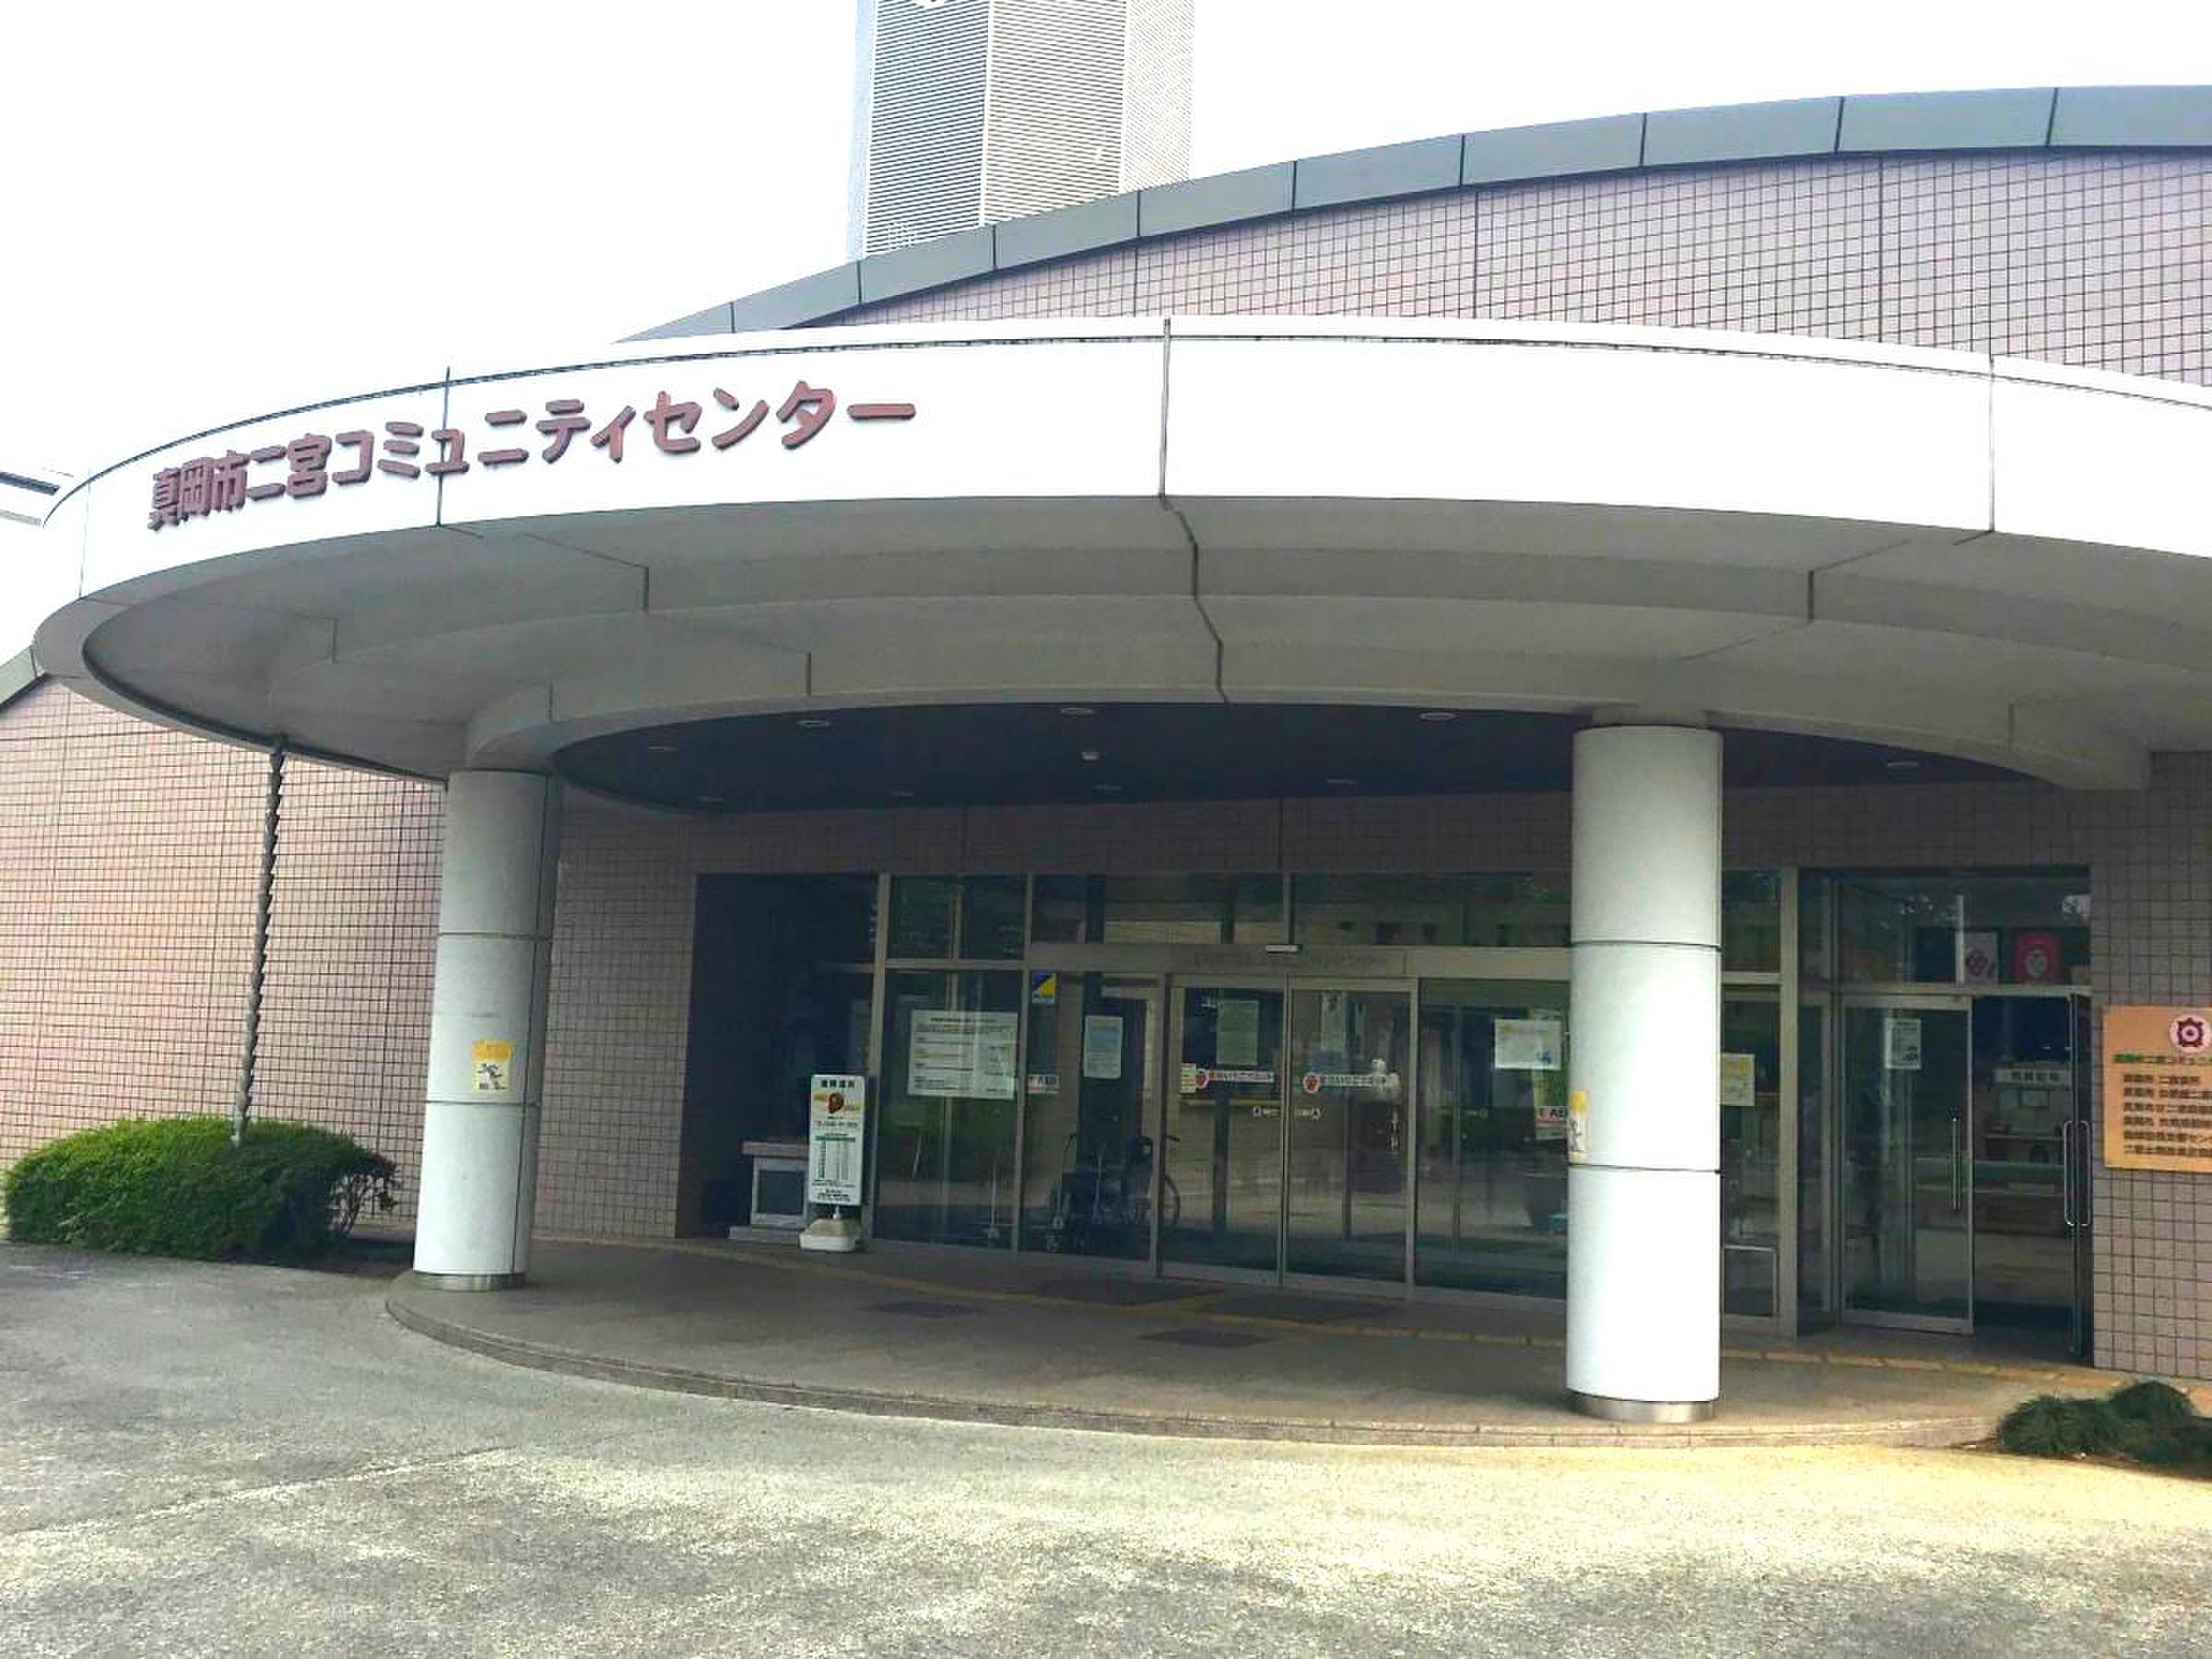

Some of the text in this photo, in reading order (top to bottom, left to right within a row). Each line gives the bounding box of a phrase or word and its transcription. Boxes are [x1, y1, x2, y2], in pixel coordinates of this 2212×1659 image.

[147, 381, 916, 532] 真岡市二宮コミュニティセンター
